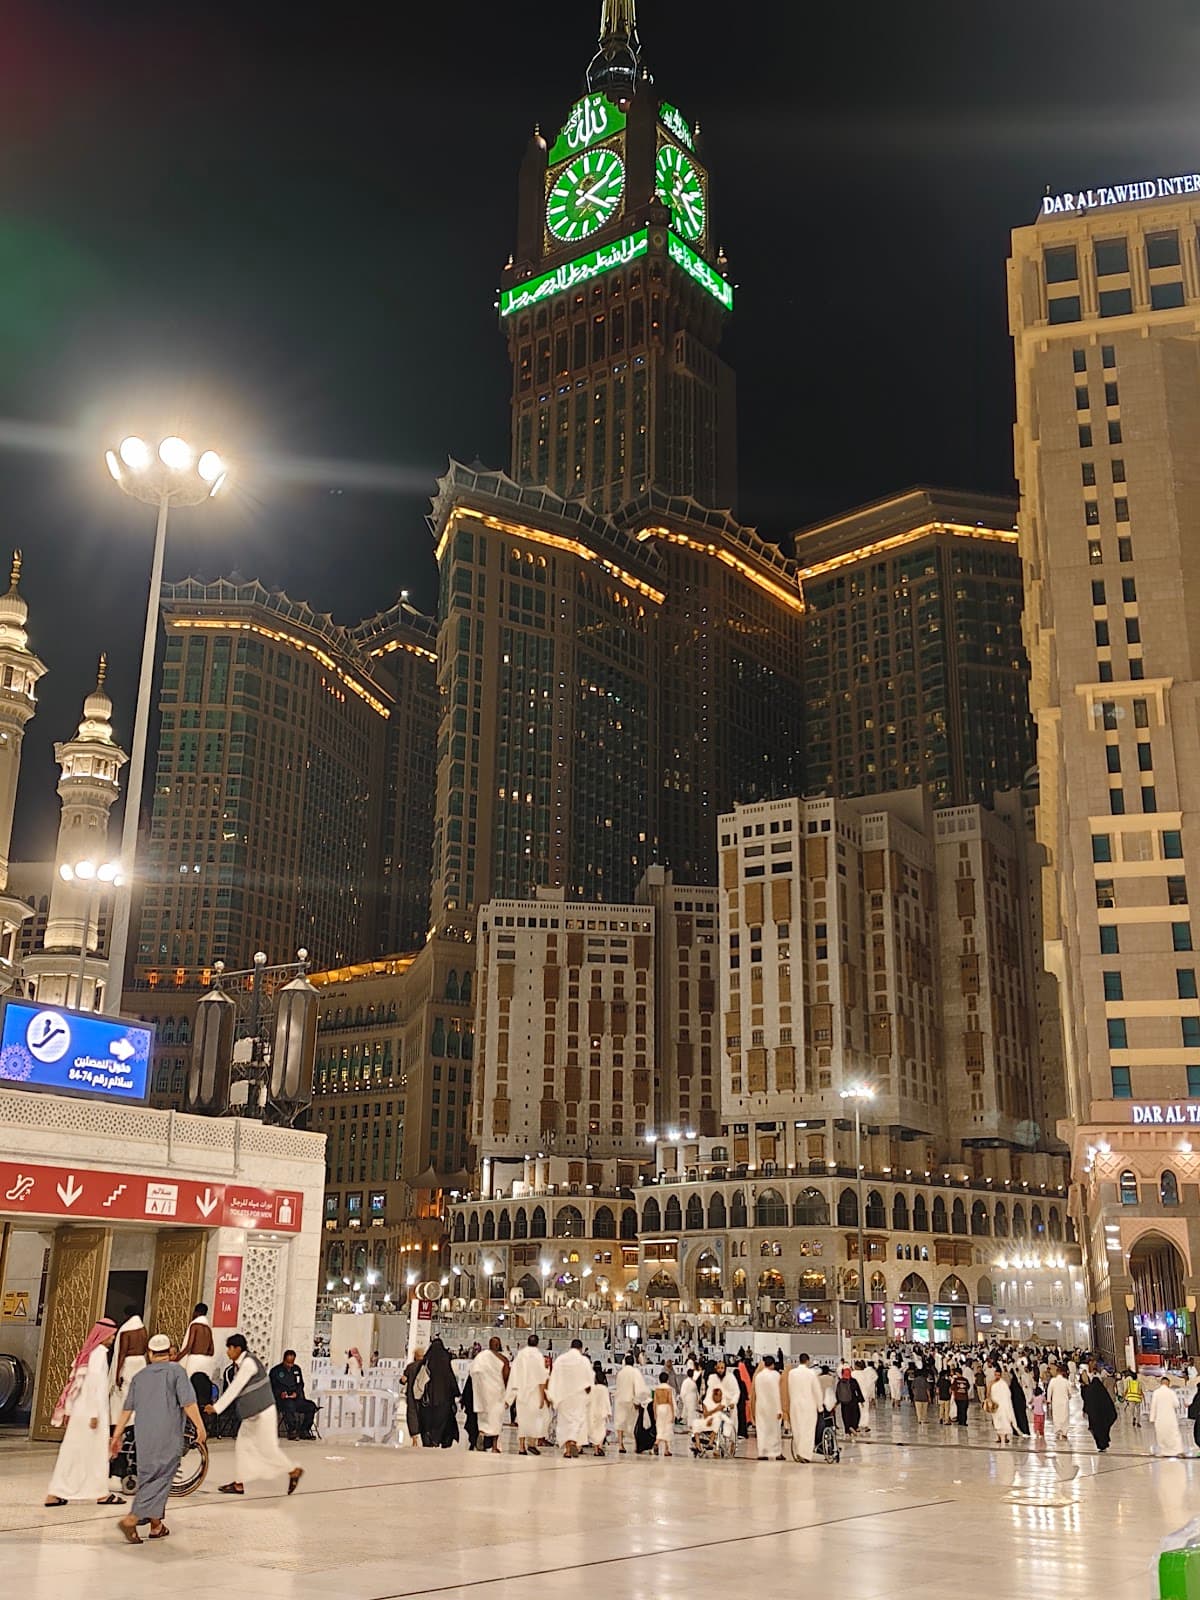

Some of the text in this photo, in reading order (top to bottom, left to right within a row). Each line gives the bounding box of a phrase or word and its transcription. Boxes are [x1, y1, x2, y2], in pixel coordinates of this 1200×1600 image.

[1043, 194, 1074, 214] DAR
[1077, 190, 1098, 208] AL
[1098, 181, 1156, 206] TAWHID
[1133, 1105, 1163, 1123] DAR
[1166, 1105, 1186, 1123] AL
[218, 1286, 238, 1294] STAIRS
